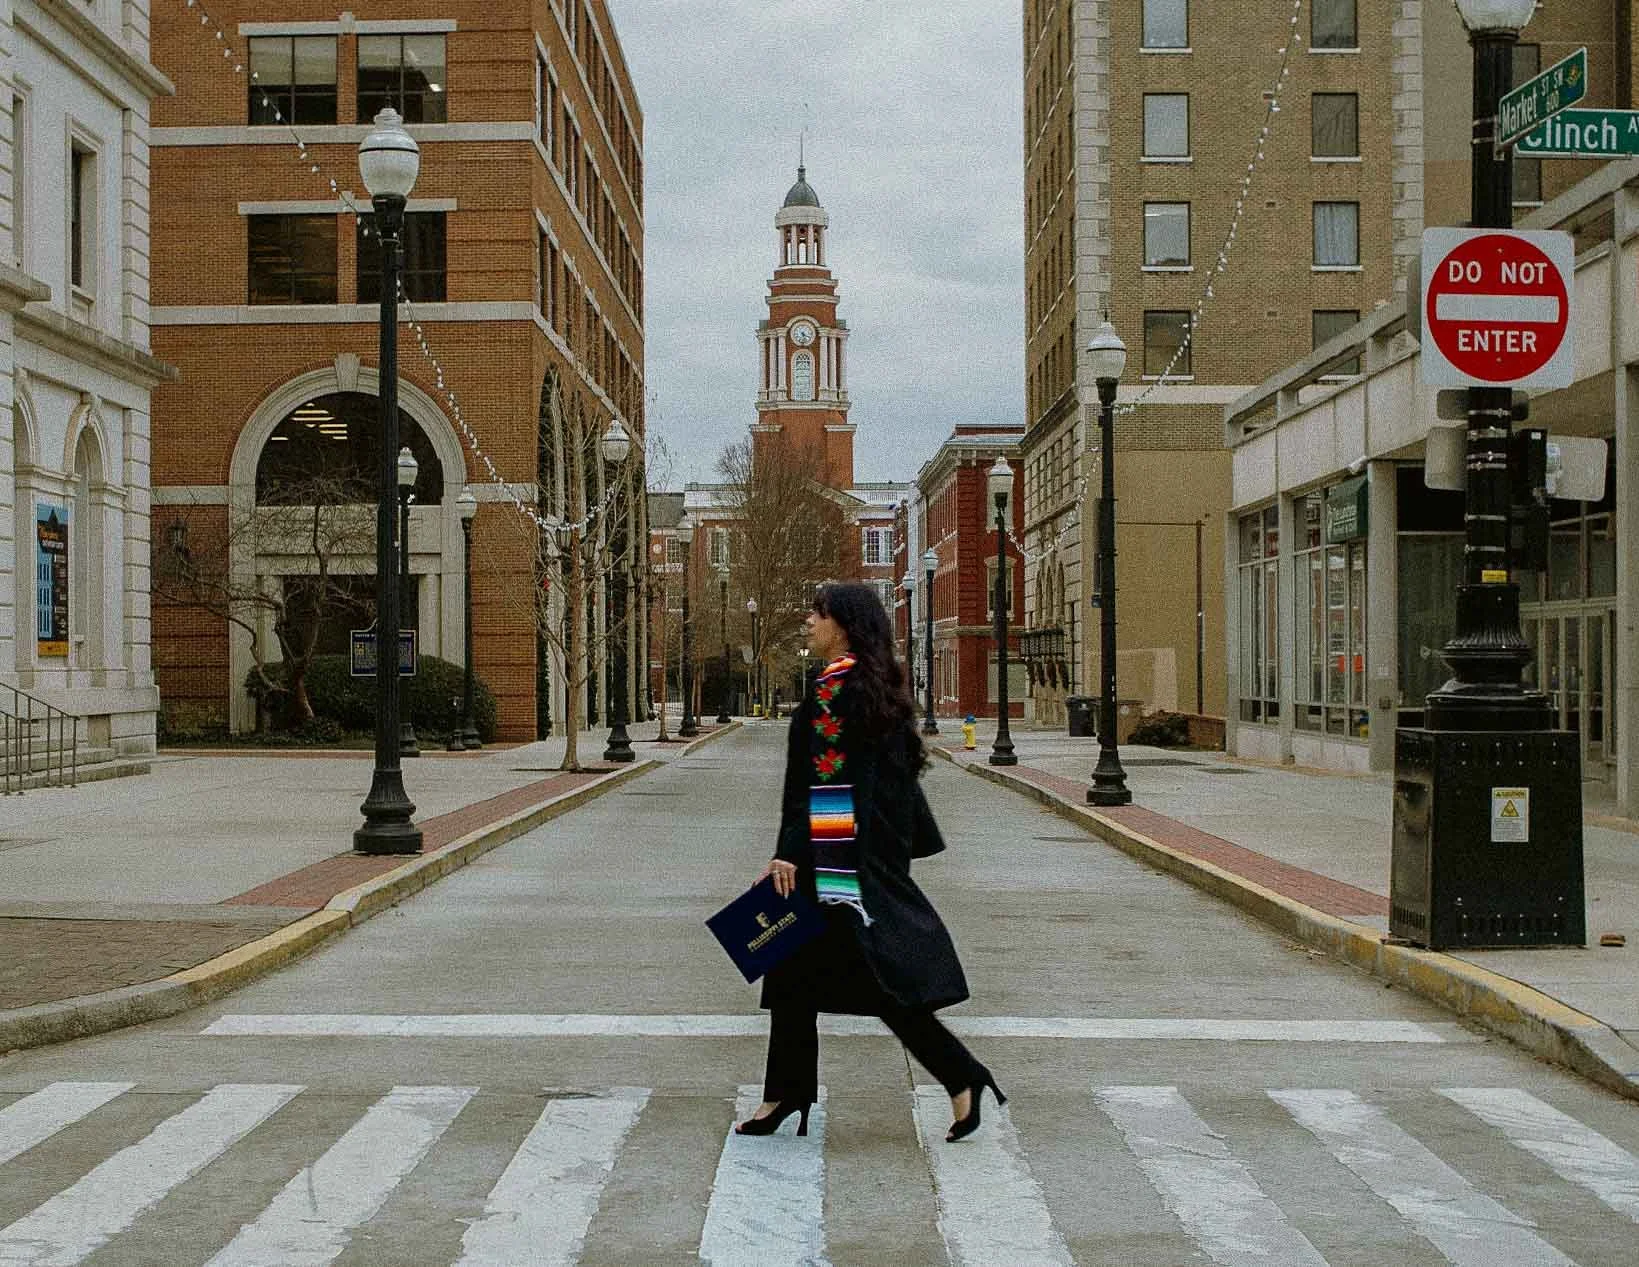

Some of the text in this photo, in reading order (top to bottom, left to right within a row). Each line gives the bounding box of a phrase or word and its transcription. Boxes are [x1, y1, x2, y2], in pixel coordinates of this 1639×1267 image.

[1502, 86, 1537, 138] Market
[1448, 260, 1548, 285] DO NOT
[1457, 329, 1537, 353] ENTER
